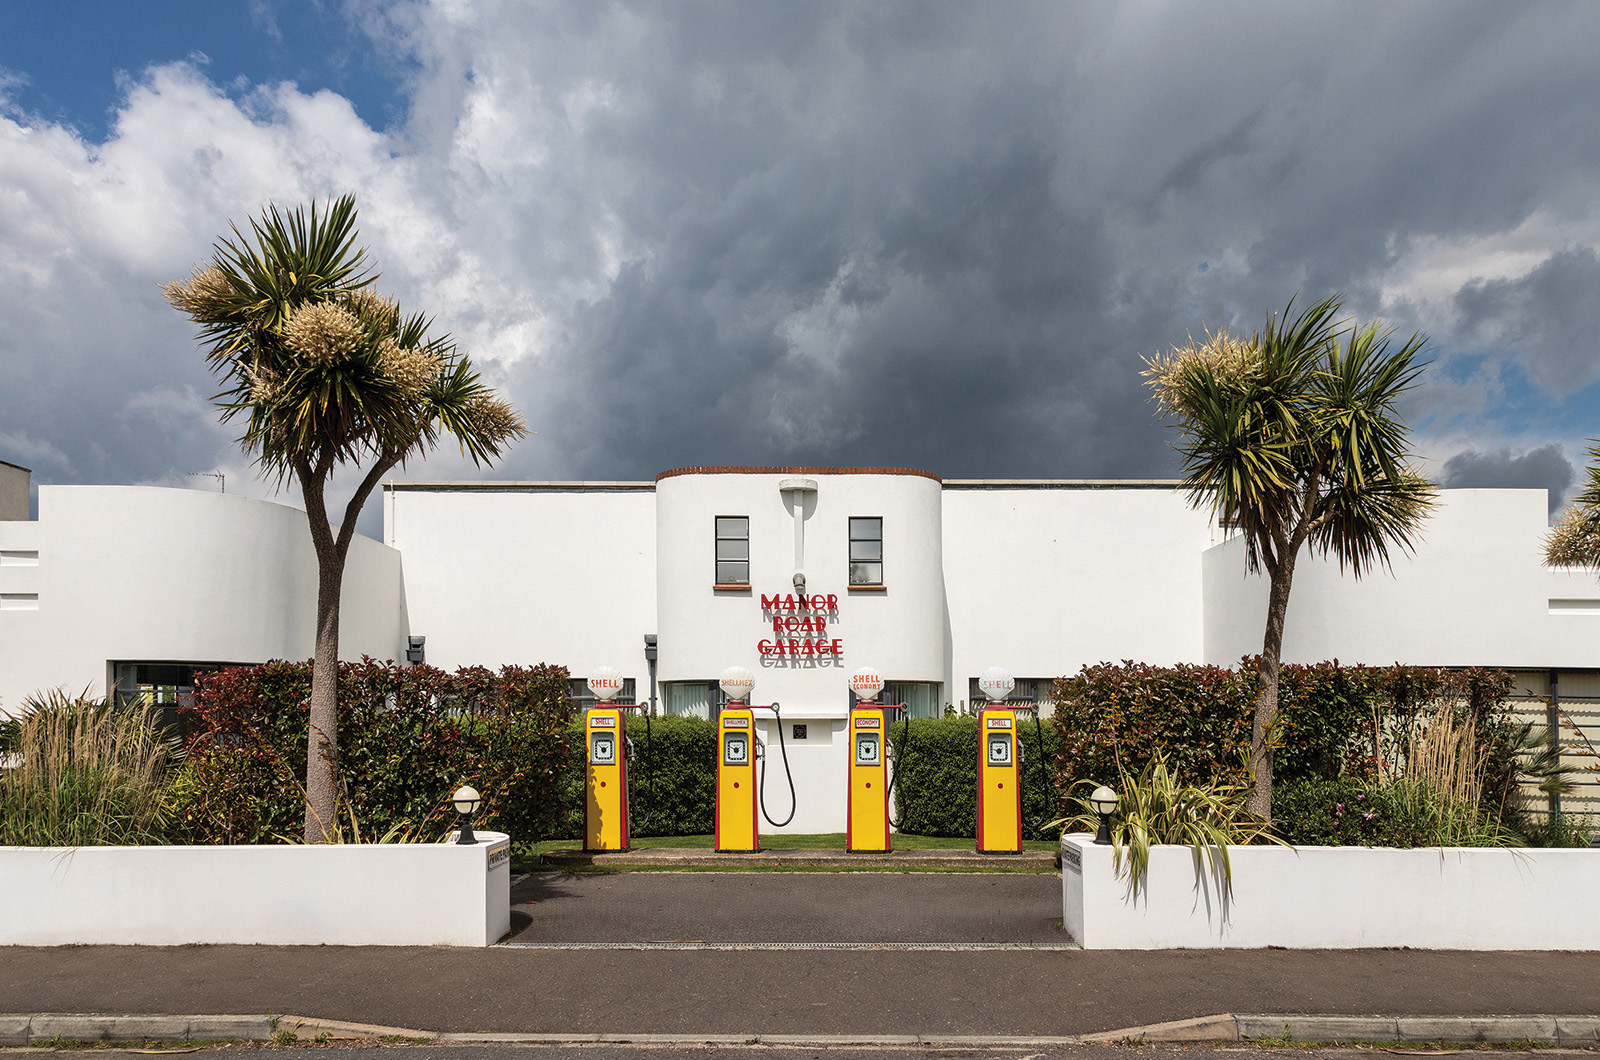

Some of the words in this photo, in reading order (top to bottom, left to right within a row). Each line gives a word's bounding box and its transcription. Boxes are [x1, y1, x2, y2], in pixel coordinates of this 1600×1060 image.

[761, 593, 838, 610] MANOR
[772, 616, 826, 632] ROAD
[757, 639, 843, 655] GARAGE
[591, 679, 619, 688] SHELL
[853, 675, 880, 683] SHELL
[983, 680, 1011, 689] SHELL
[595, 718, 611, 726] SHELL
[991, 719, 1007, 727] SHELL
